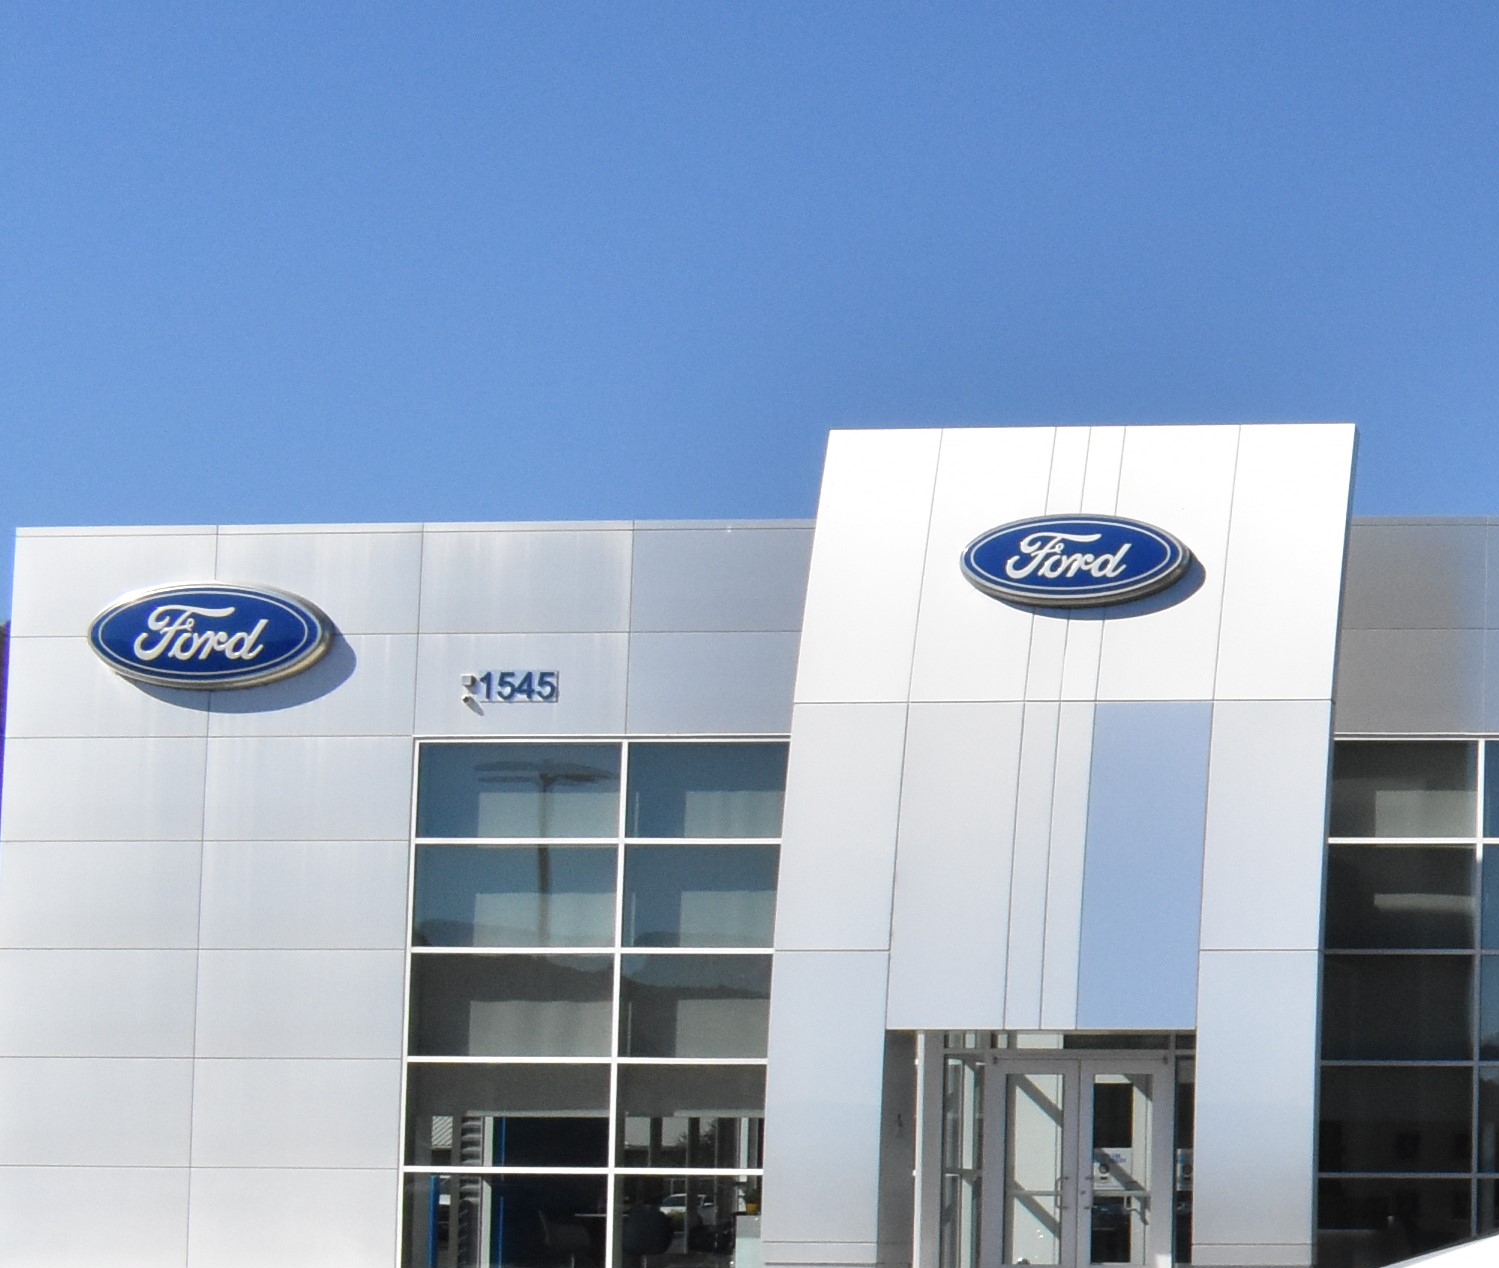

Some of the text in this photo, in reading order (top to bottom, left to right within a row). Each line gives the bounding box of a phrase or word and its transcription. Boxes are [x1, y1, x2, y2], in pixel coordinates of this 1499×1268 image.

[1005, 531, 1132, 579] Ford
[133, 604, 269, 661] Ford
[479, 671, 556, 700] 1545
